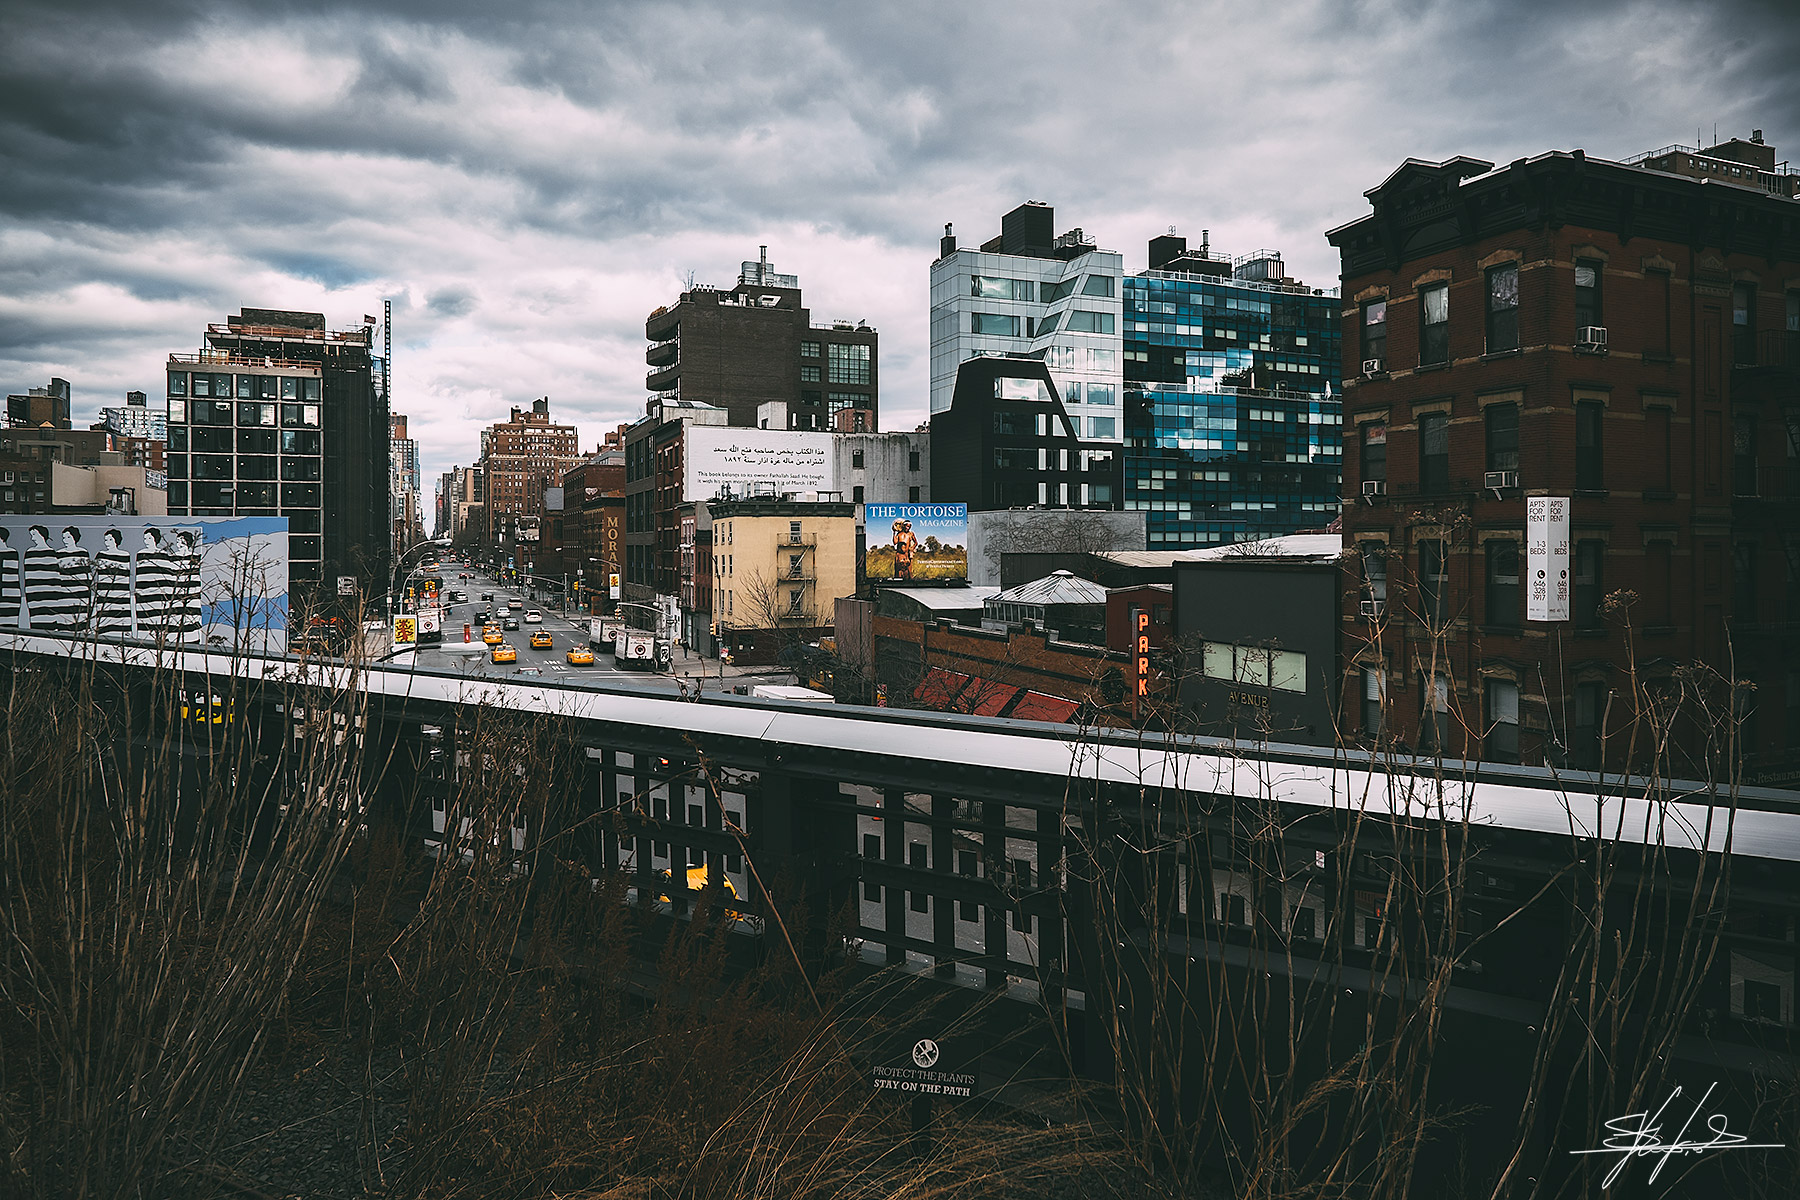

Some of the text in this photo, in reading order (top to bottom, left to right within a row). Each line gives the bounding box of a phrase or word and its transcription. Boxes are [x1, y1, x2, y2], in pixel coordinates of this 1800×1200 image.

[870, 506, 964, 517] THE TORTOISE
[607, 516, 619, 574] MORAN
[1138, 614, 1149, 696] PARK
[1228, 691, 1269, 708] AVENUE
[873, 1066, 975, 1085] PROTECT THE PLANTS
[873, 1079, 971, 1097] STAY ON THE PATH
